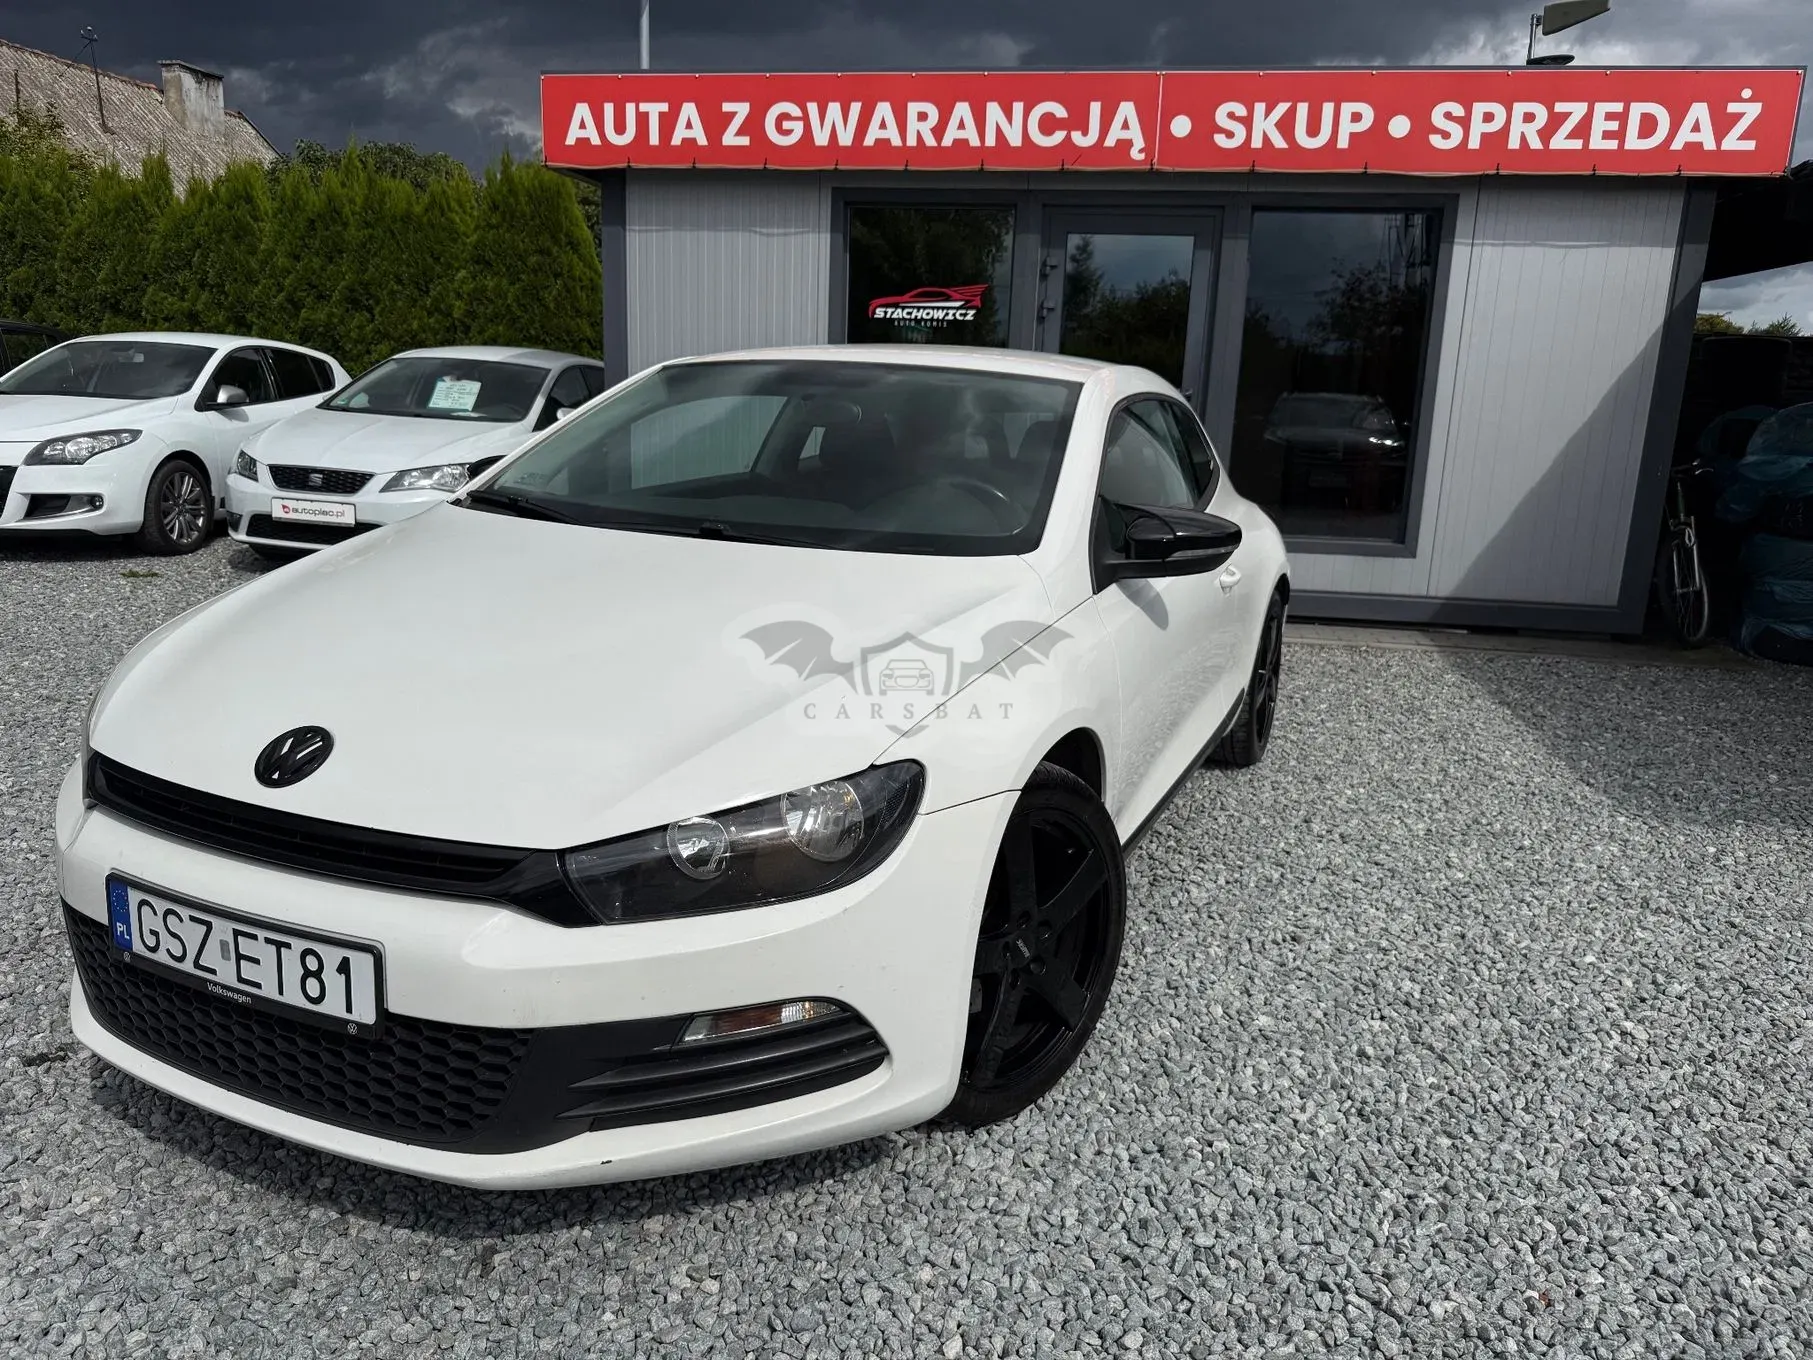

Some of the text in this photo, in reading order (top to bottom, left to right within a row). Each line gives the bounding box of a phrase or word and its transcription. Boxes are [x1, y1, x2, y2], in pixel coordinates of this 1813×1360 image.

[565, 88, 1764, 160] AUTA Z GWARANCJĄ SKUP SPRZEDAŻ
[873, 307, 977, 321] STACHOWICZ
[291, 506, 346, 518] autoplac.pl
[116, 921, 130, 940] PL
[206, 981, 252, 1005] Volkswagen
